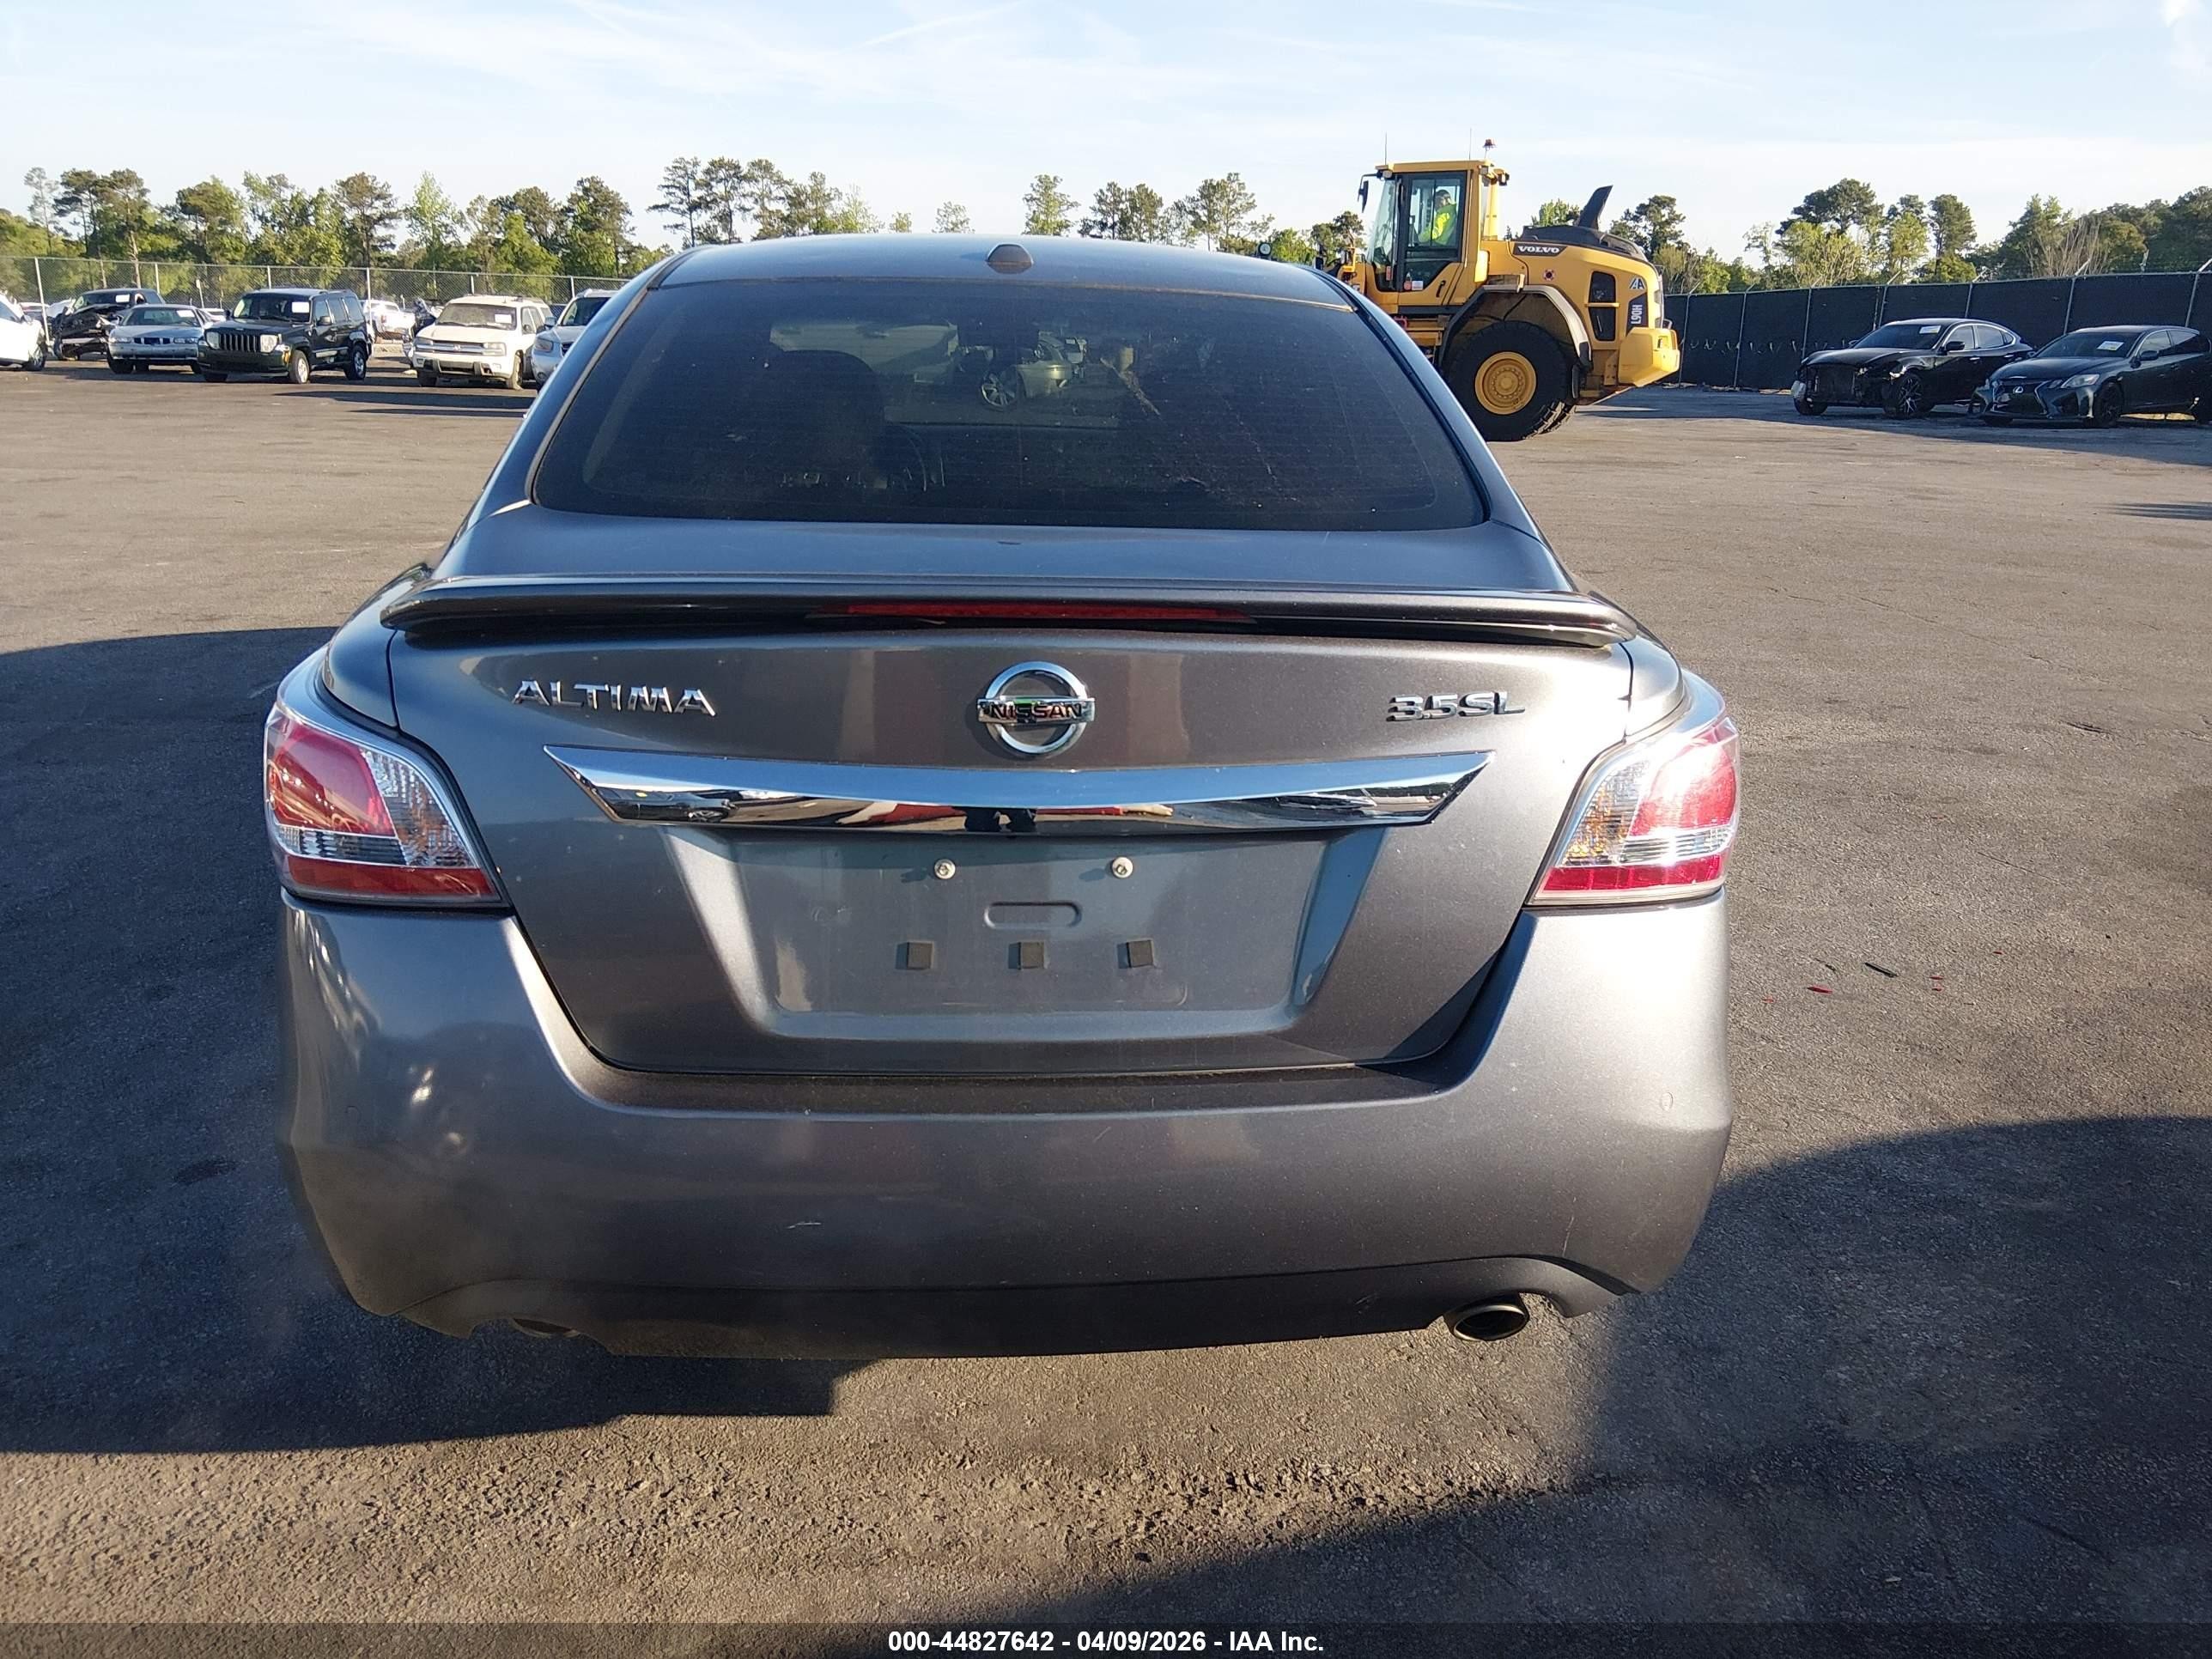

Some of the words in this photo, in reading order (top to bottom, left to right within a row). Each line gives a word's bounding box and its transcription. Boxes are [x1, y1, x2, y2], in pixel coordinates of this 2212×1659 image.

[1631, 304, 1643, 325] L90H
[512, 678, 716, 717] ALTIMA
[985, 701, 1084, 721] NISSAN
